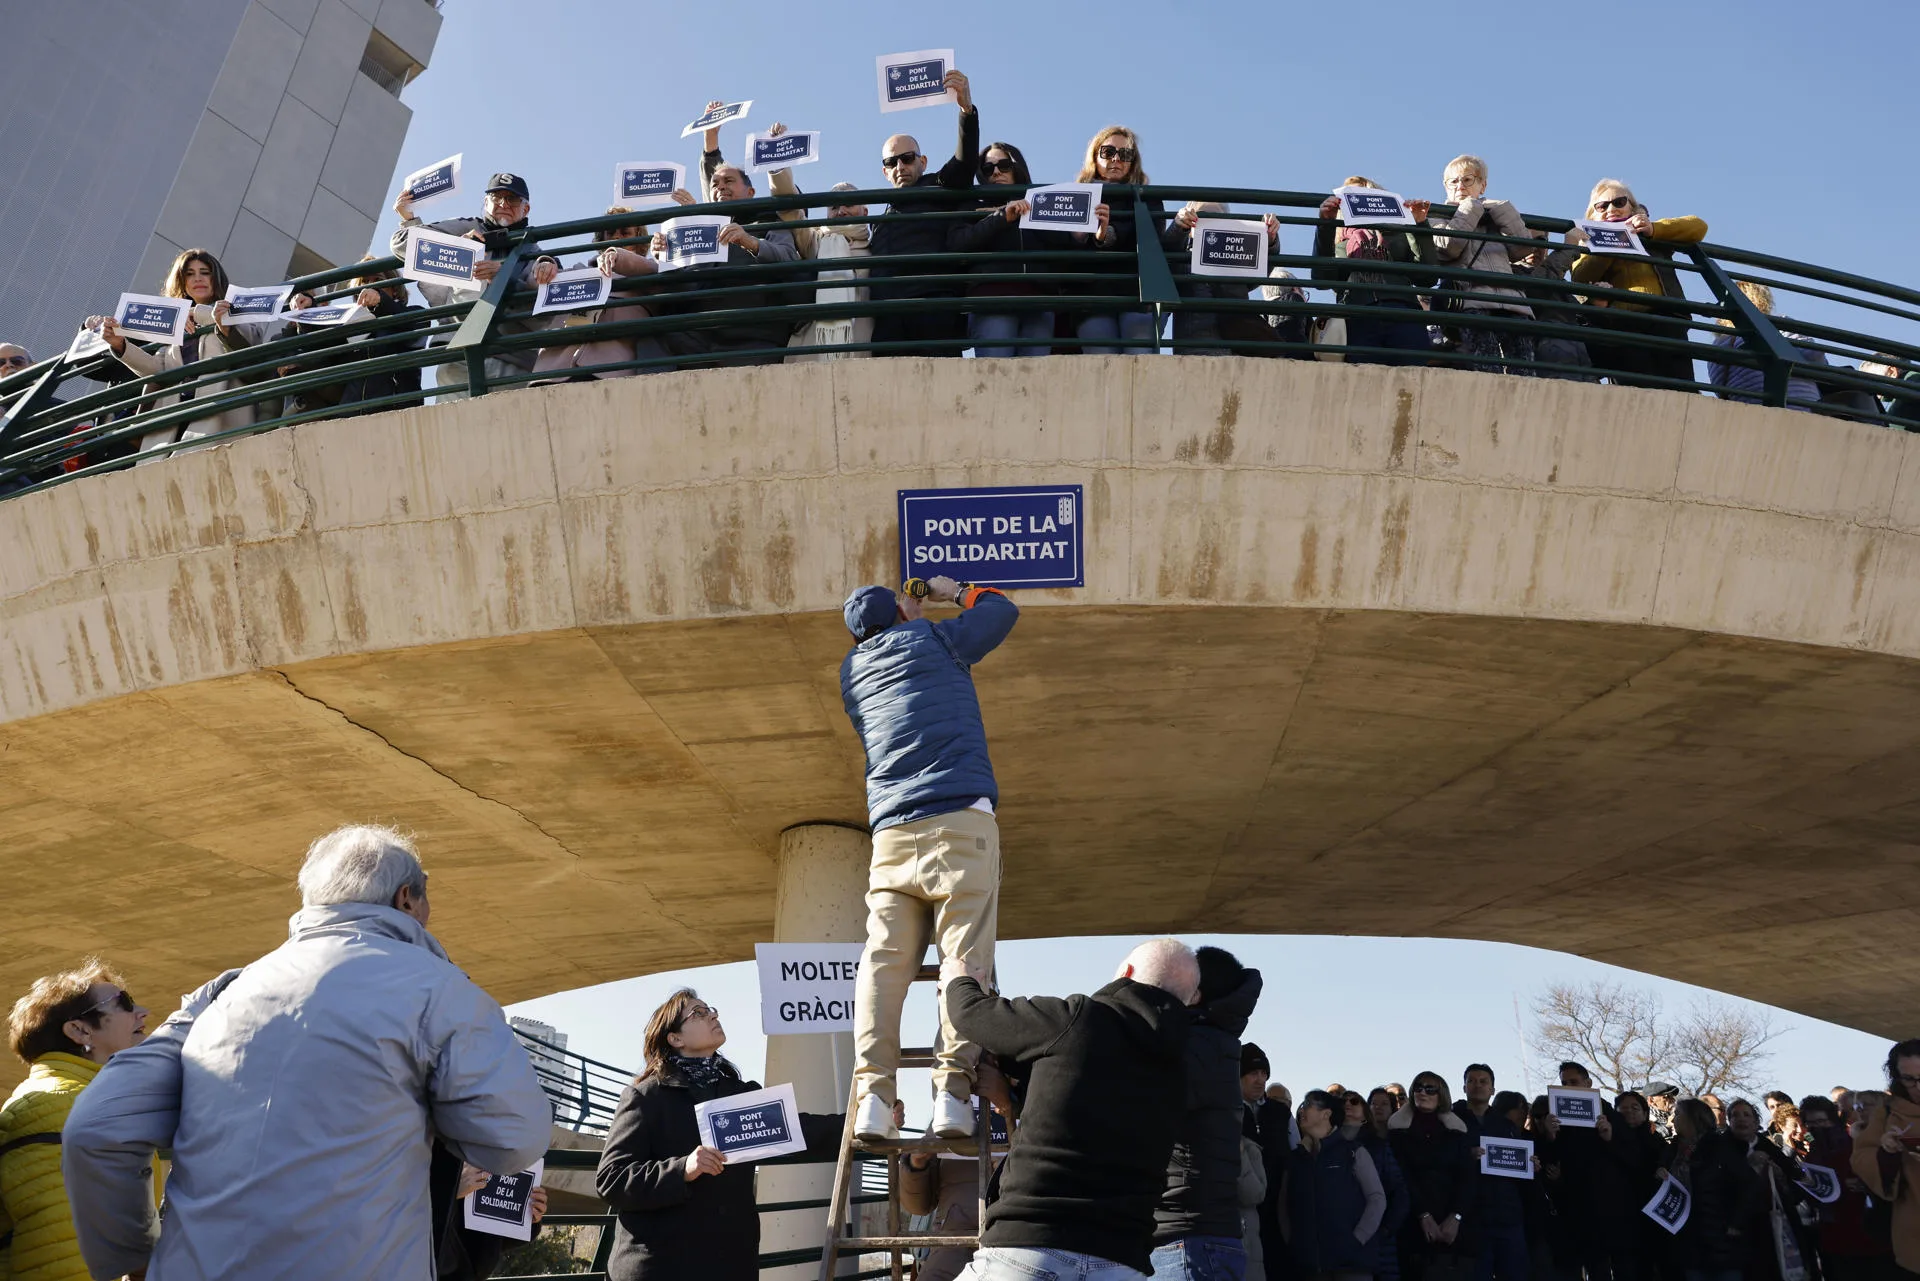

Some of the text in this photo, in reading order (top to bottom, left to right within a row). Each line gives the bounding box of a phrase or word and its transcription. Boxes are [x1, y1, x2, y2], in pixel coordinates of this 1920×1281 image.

[896, 80, 940, 93] SOLIDARITAT
[761, 147, 804, 159] SOLIDARITAT
[500, 174, 513, 184] S
[414, 178, 449, 194] SOLIDARITAT
[629, 183, 670, 191] SOLIDARITAT
[1209, 252, 1254, 260] SOLIDARITAT
[422, 259, 469, 272] SOLIDARITAT
[552, 293, 595, 302] SOLIDARITAT
[128, 318, 170, 329] SOLIDARITAT
[925, 516, 1057, 536] PONT DE LA
[914, 541, 1068, 564] SOLIDARITAT
[740, 1112, 763, 1121] PONT
[724, 1128, 781, 1144] SOLIDARITAT
[500, 1175, 518, 1186] PONT
[496, 1186, 514, 1198] DE LA
[481, 1196, 522, 1212] SOLIDARITAT
